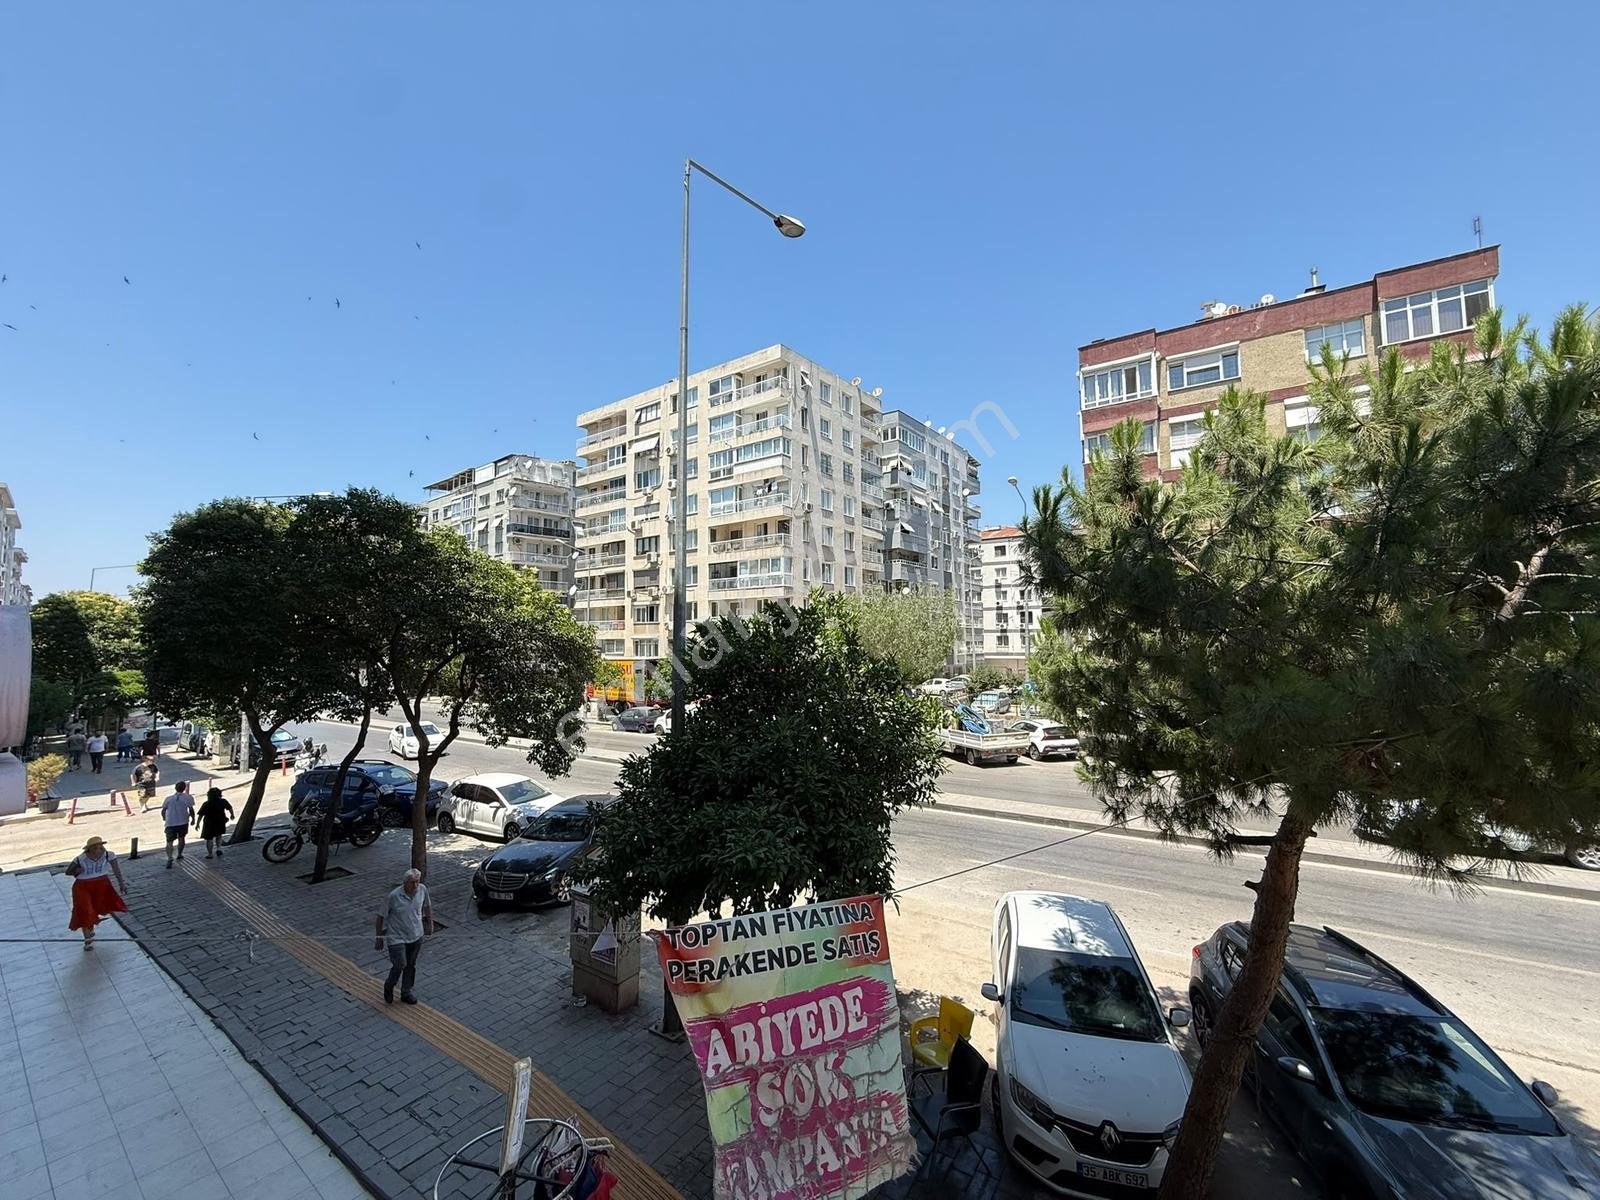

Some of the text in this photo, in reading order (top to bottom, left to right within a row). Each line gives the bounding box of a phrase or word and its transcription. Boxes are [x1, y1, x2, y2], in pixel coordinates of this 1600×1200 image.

[665, 902, 873, 950] TOPTAN FİYATINA
[667, 931, 881, 983] PERAKENDE SATIŞ
[706, 986, 868, 1078] ABİYEDE
[1083, 1165, 1145, 1187] 35 ABK 692
